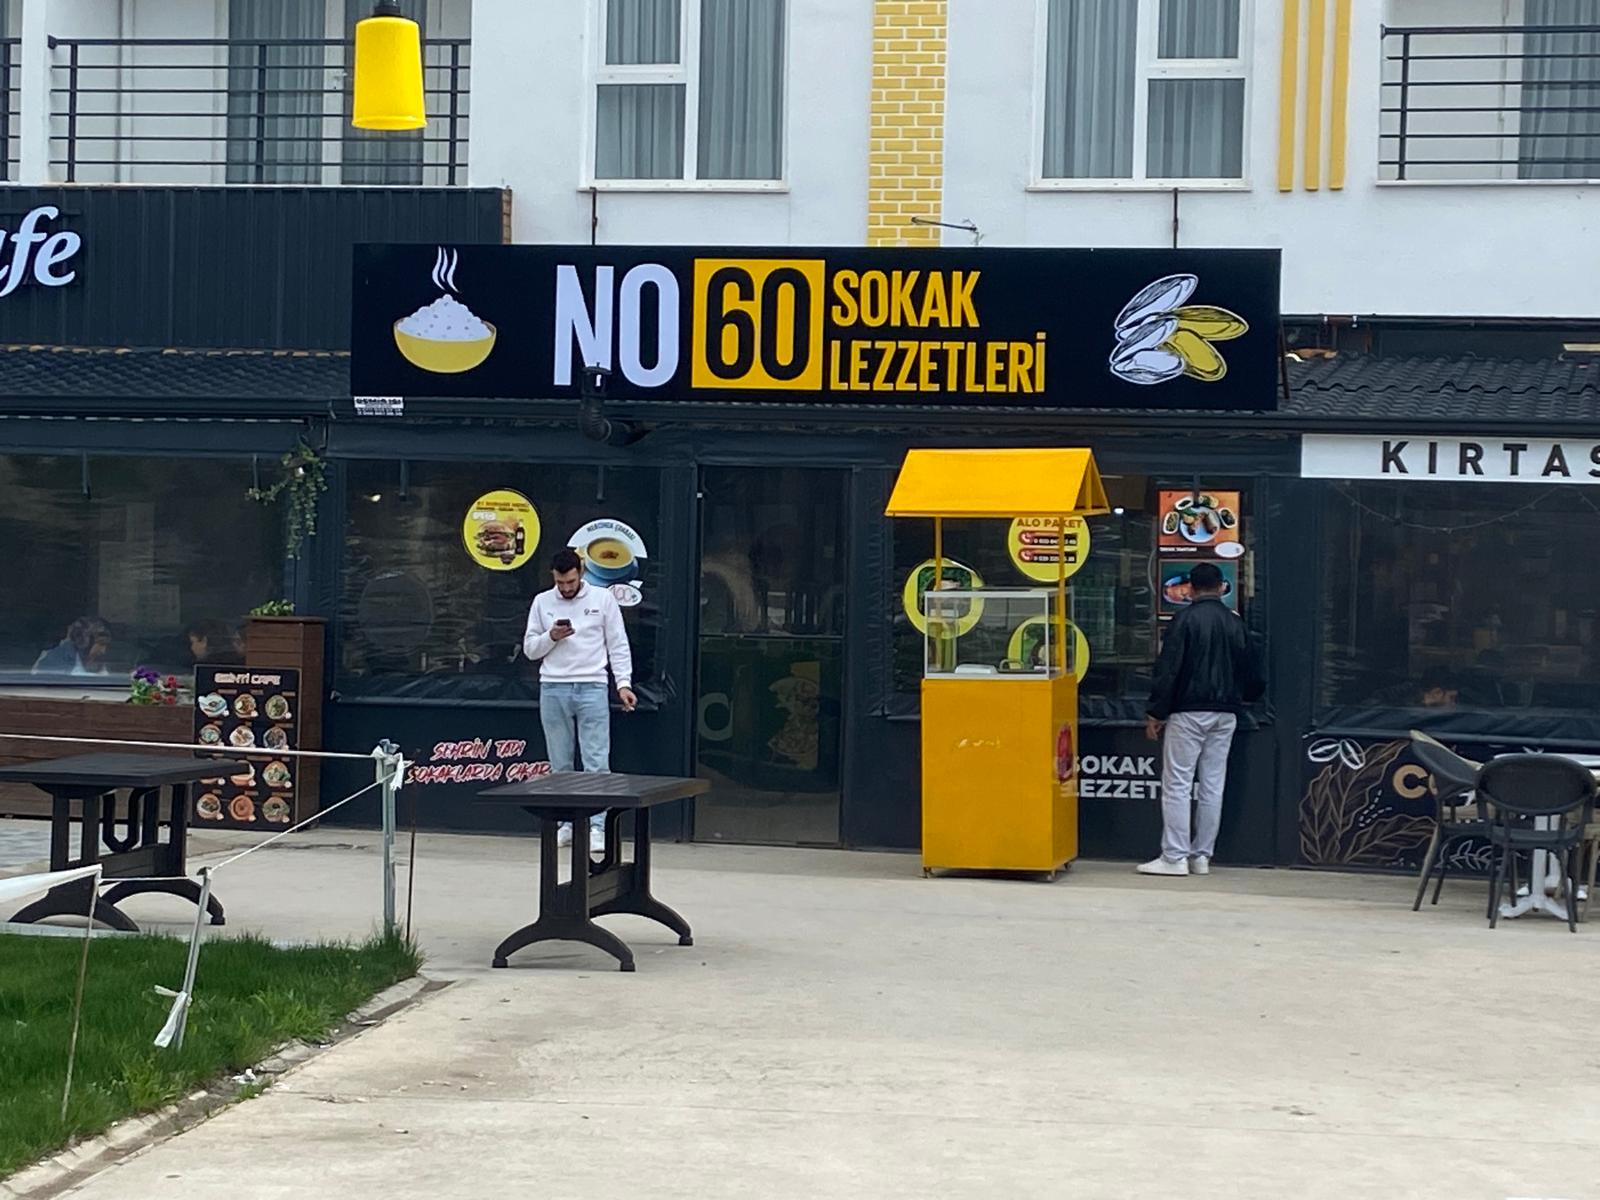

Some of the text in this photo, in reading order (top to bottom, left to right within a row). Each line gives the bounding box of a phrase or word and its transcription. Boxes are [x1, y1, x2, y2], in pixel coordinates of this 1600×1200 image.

[0, 206, 81, 297] fe
[553, 263, 812, 388] NO 60
[831, 269, 982, 328] SOKAK
[830, 331, 1047, 394] LEZZETLERİ
[1017, 518, 1040, 527] ALO
[1073, 755, 1156, 776] OKAK
